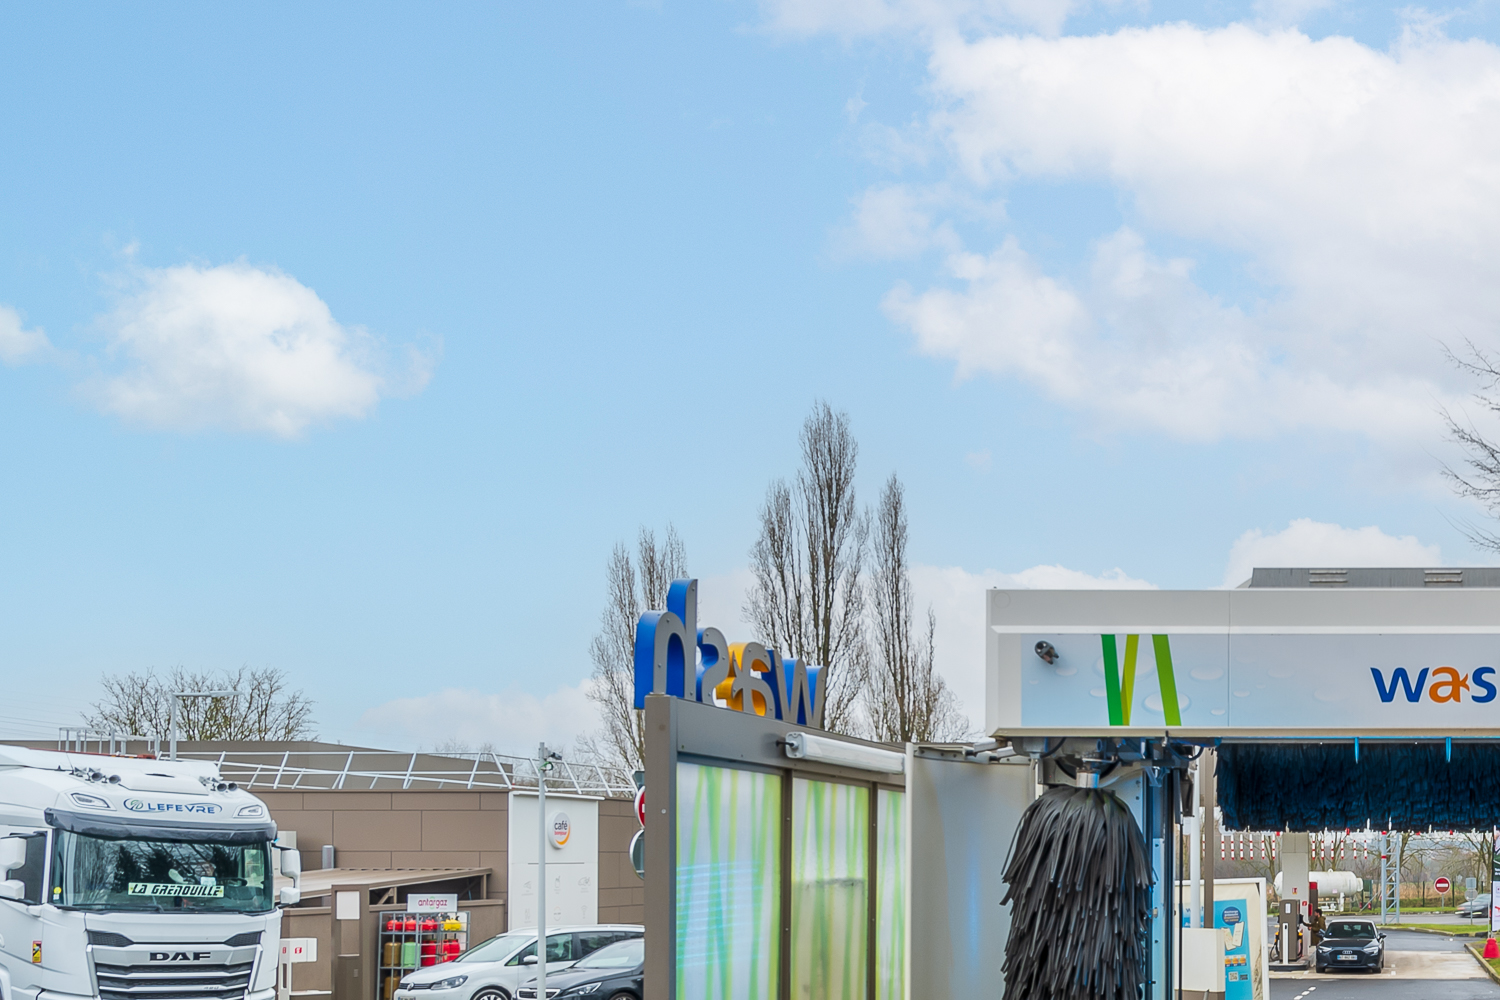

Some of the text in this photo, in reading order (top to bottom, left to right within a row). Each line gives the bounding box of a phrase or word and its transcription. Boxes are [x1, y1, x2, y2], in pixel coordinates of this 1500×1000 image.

[147, 802, 216, 814] LEFEVRE
[554, 820, 568, 830] café
[132, 884, 147, 894] LA
[418, 898, 447, 909] antargaz
[149, 952, 211, 961] DAF
